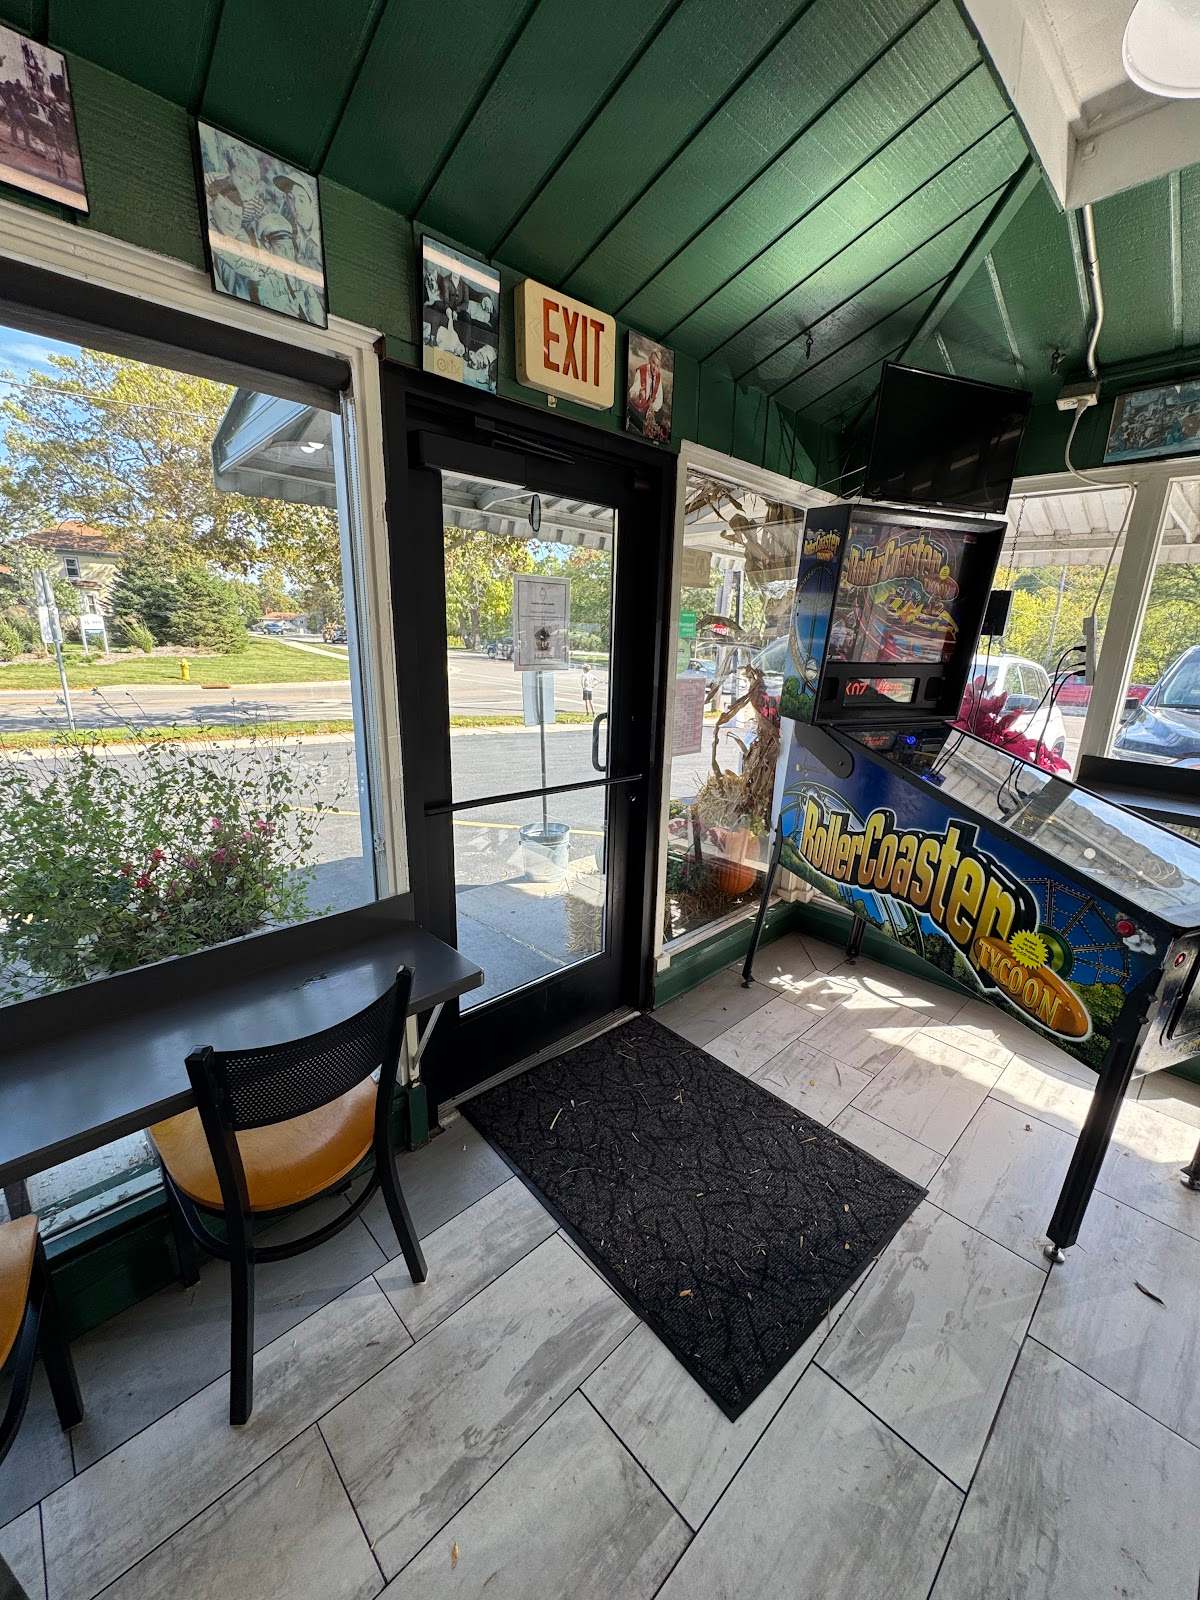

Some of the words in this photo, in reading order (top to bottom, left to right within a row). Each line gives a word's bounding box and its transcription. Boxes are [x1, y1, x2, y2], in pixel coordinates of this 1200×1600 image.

[543, 298, 605, 387] EXIT
[801, 799, 1016, 967] RollerCoaster
[978, 941, 1062, 1027] TYCOON
